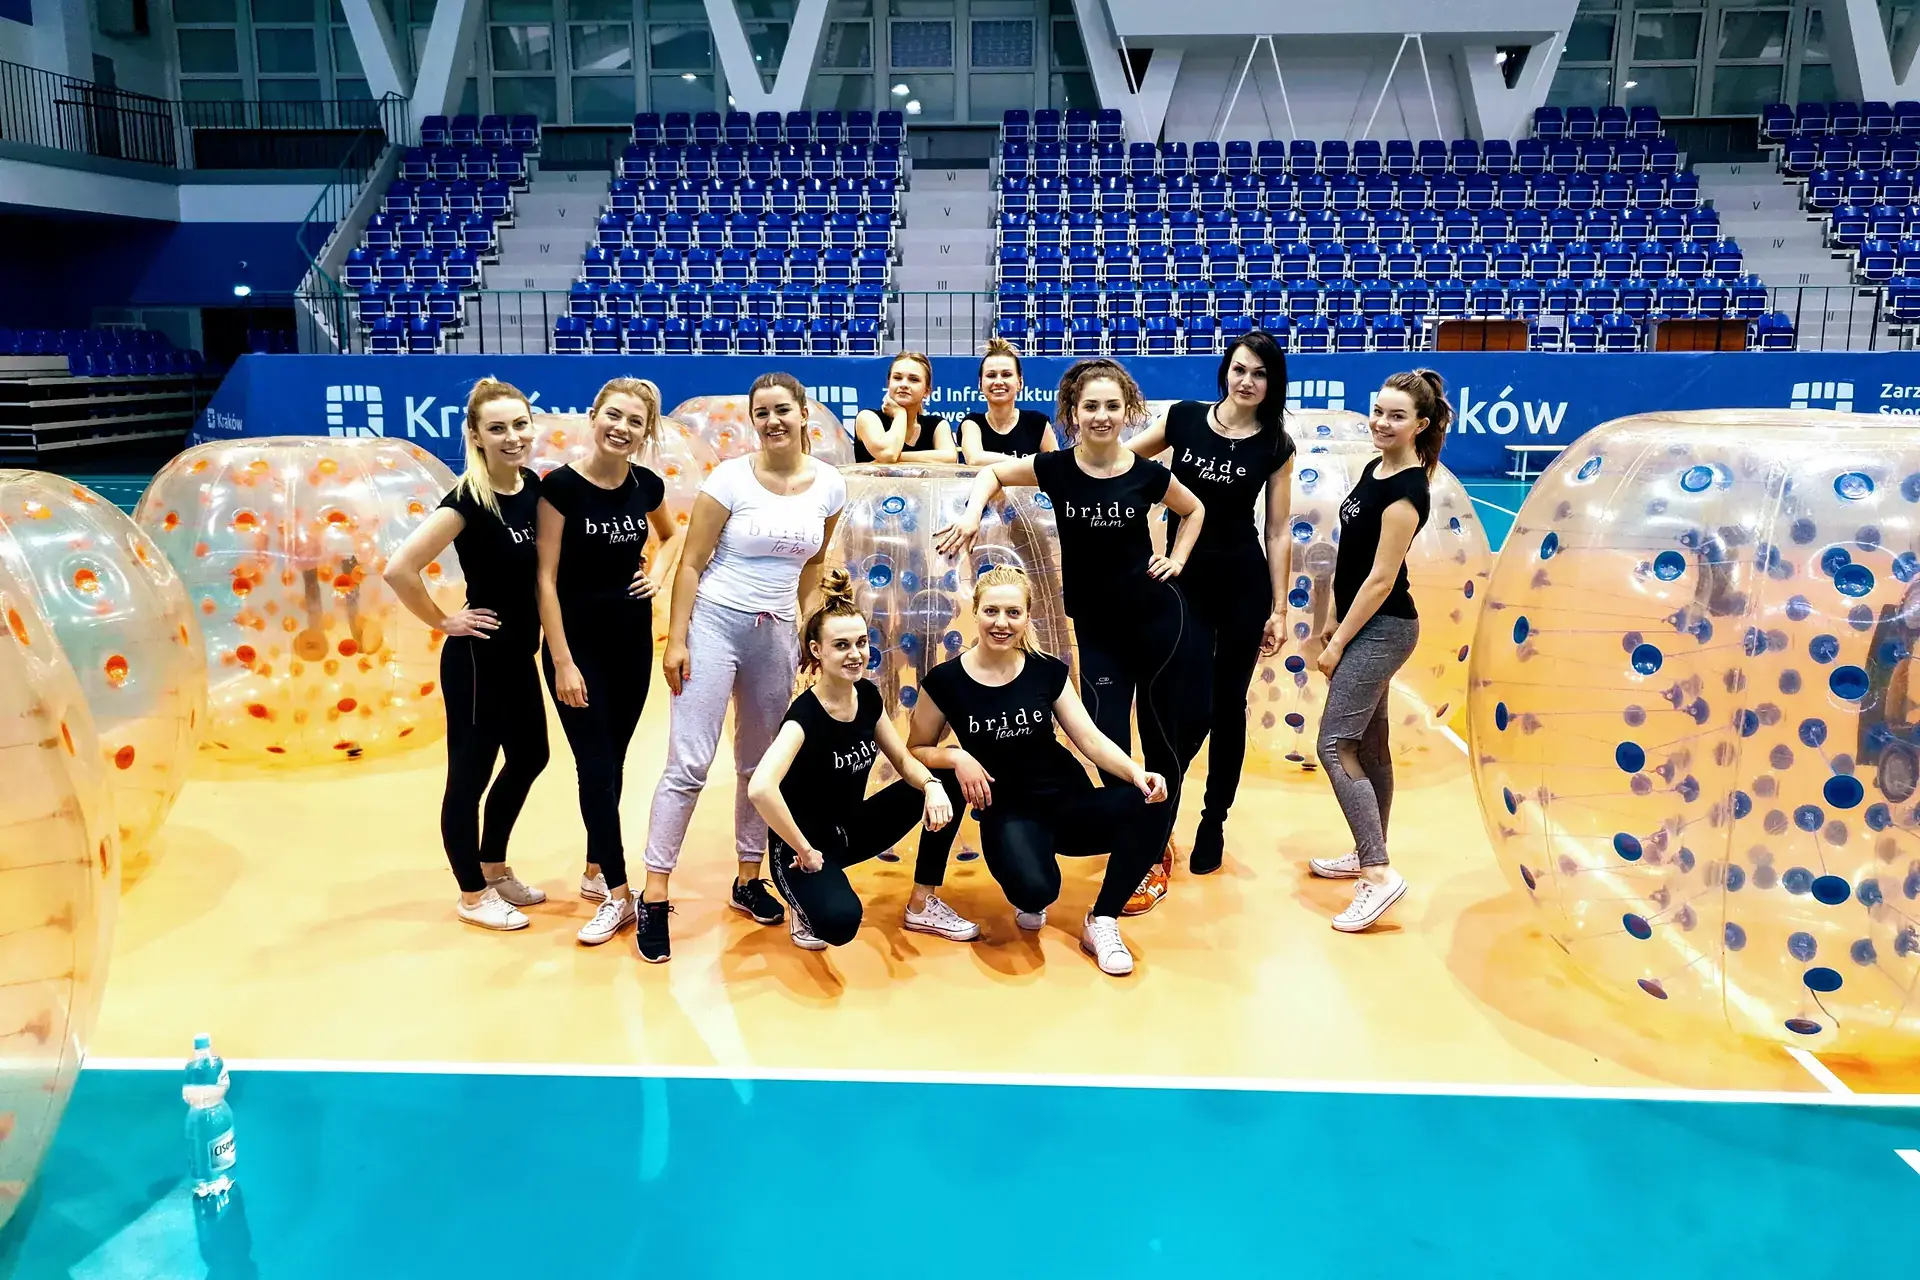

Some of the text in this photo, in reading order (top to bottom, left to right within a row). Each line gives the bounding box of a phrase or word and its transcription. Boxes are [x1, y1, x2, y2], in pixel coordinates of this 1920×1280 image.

[1730, 165, 1741, 174] VI
[568, 173, 578, 182] VI
[946, 172, 956, 181] VI
[1752, 201, 1761, 210] V
[558, 208, 566, 218] V
[944, 207, 951, 217] V
[540, 244, 550, 254] IV
[940, 244, 950, 254] IV
[1772, 239, 1784, 248] IV
[524, 278, 534, 288] III
[937, 280, 948, 290] III
[1798, 274, 1810, 284] III
[936, 316, 942, 327] II
[1369, 385, 1568, 434] ków
[217, 412, 243, 431] Kraków
[1181, 448, 1246, 476] bride
[1198, 466, 1234, 484] team
[1066, 502, 1136, 518] bride
[585, 516, 647, 534] bride
[1090, 514, 1126, 528] team
[609, 530, 640, 544] team
[748, 519, 820, 546] bride
[968, 708, 1043, 734] bride
[995, 723, 1033, 740] team
[832, 740, 876, 769] bride
[852, 758, 872, 774] team
